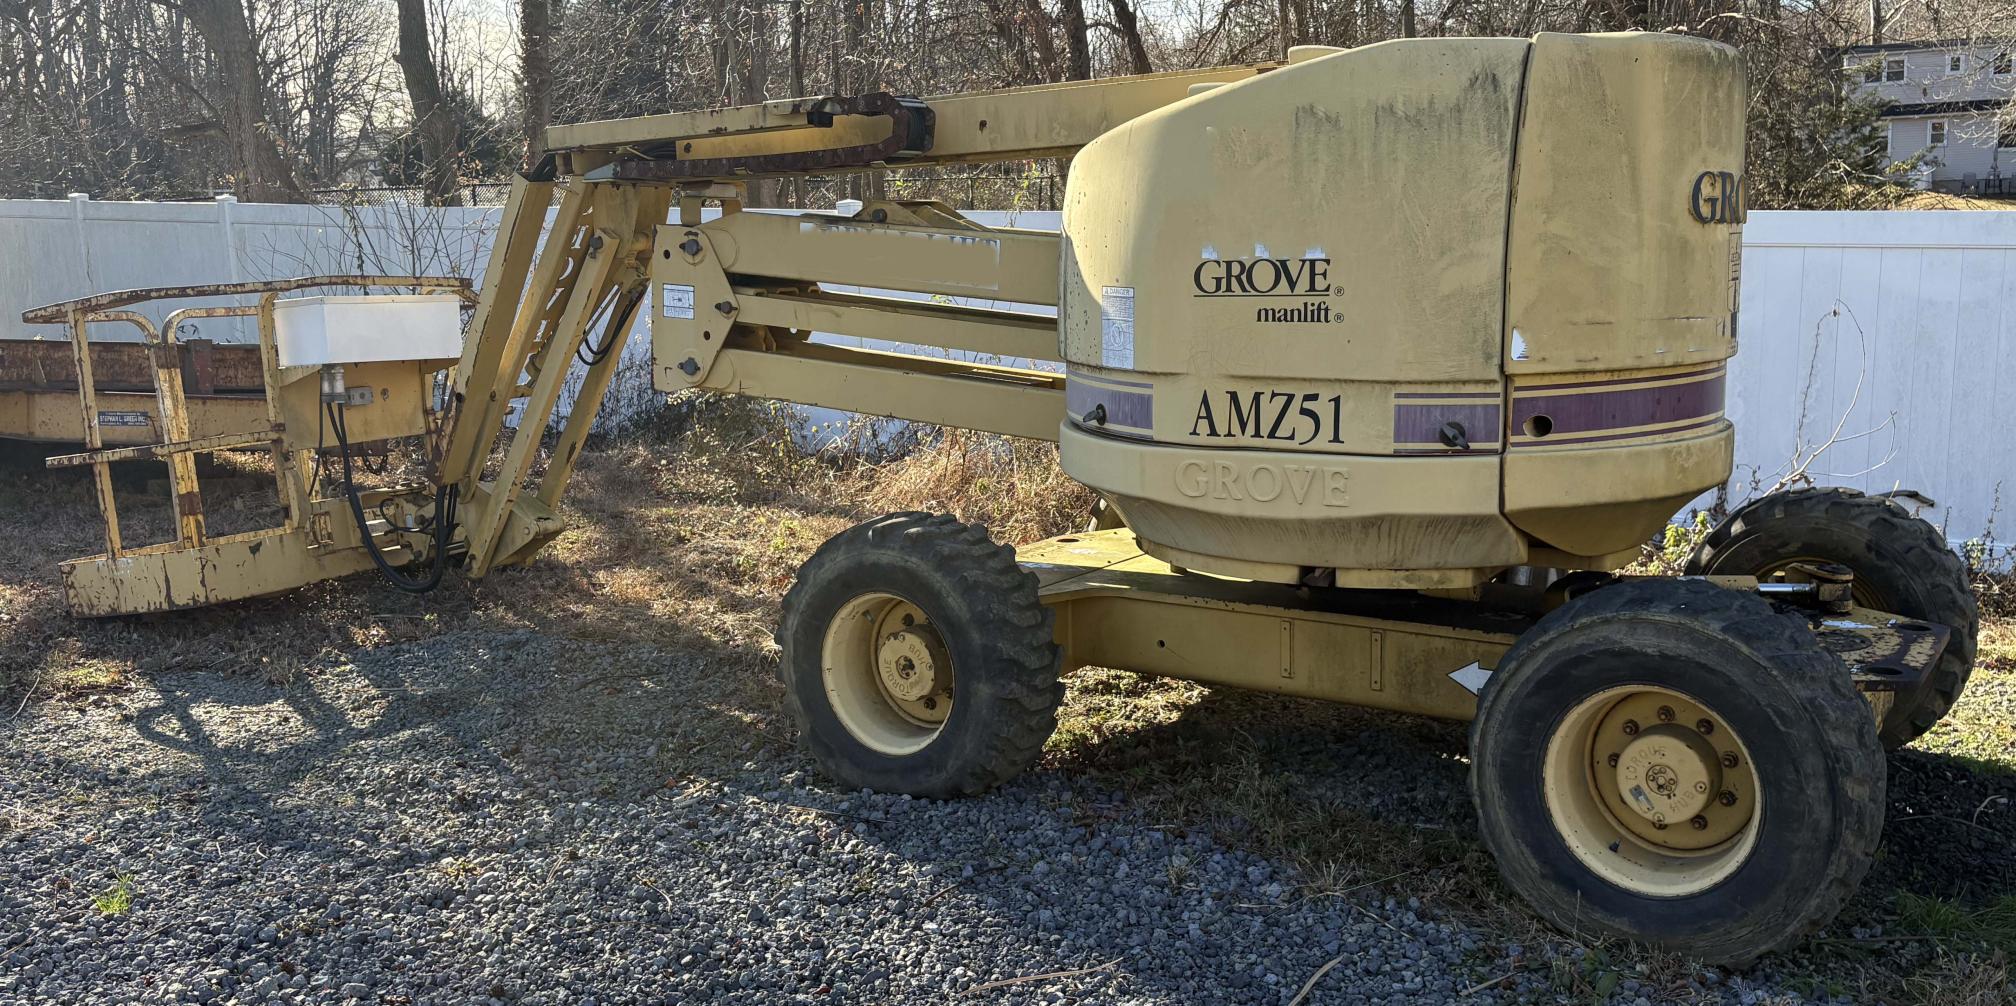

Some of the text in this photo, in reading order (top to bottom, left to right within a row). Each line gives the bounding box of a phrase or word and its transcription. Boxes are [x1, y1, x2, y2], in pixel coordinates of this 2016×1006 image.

[1189, 389, 1345, 446] AMZ51
[1175, 458, 1350, 508] GROVE
[883, 657, 911, 694] TORQUE
